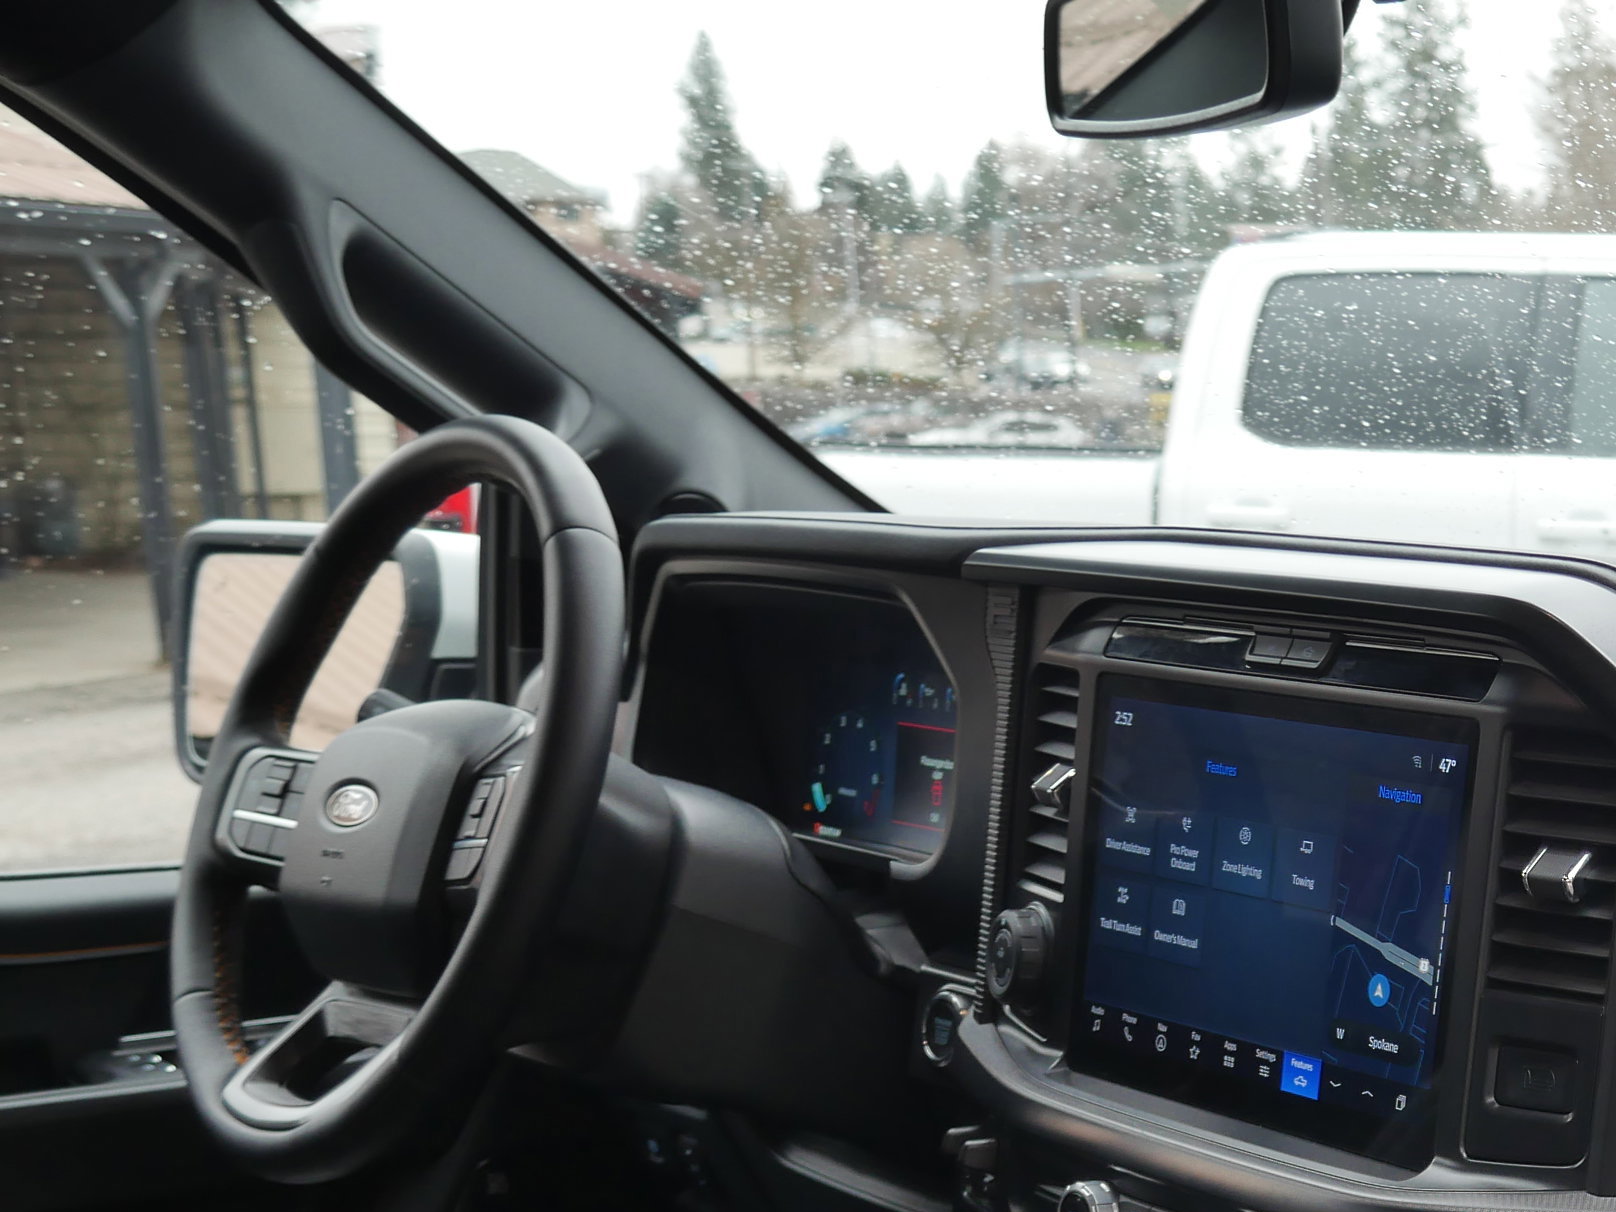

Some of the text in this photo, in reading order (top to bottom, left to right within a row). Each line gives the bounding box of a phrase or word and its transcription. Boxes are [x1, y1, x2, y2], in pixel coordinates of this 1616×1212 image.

[1206, 759, 1238, 778] Features
[1438, 757, 1457, 774] 47°
[1378, 785, 1422, 804] Navigation
[1105, 837, 1151, 856] Driver Assistance
[1170, 843, 1199, 858] Pro Power
[1170, 857, 1196, 872] Onboard
[1222, 860, 1263, 880] Zone Lighting
[1292, 873, 1315, 890] Towing
[1100, 917, 1142, 936] Trail Turn Assist
[1154, 929, 1198, 949] Owner's Manual
[1122, 1012, 1138, 1025] Phone
[1157, 1021, 1168, 1033] Nav
[1191, 1031, 1201, 1042] Fav
[1334, 1027, 1400, 1055] W Spokane
[1223, 1040, 1238, 1052] Apps
[1255, 1048, 1277, 1063] Settings
[1290, 1058, 1314, 1071] Features
